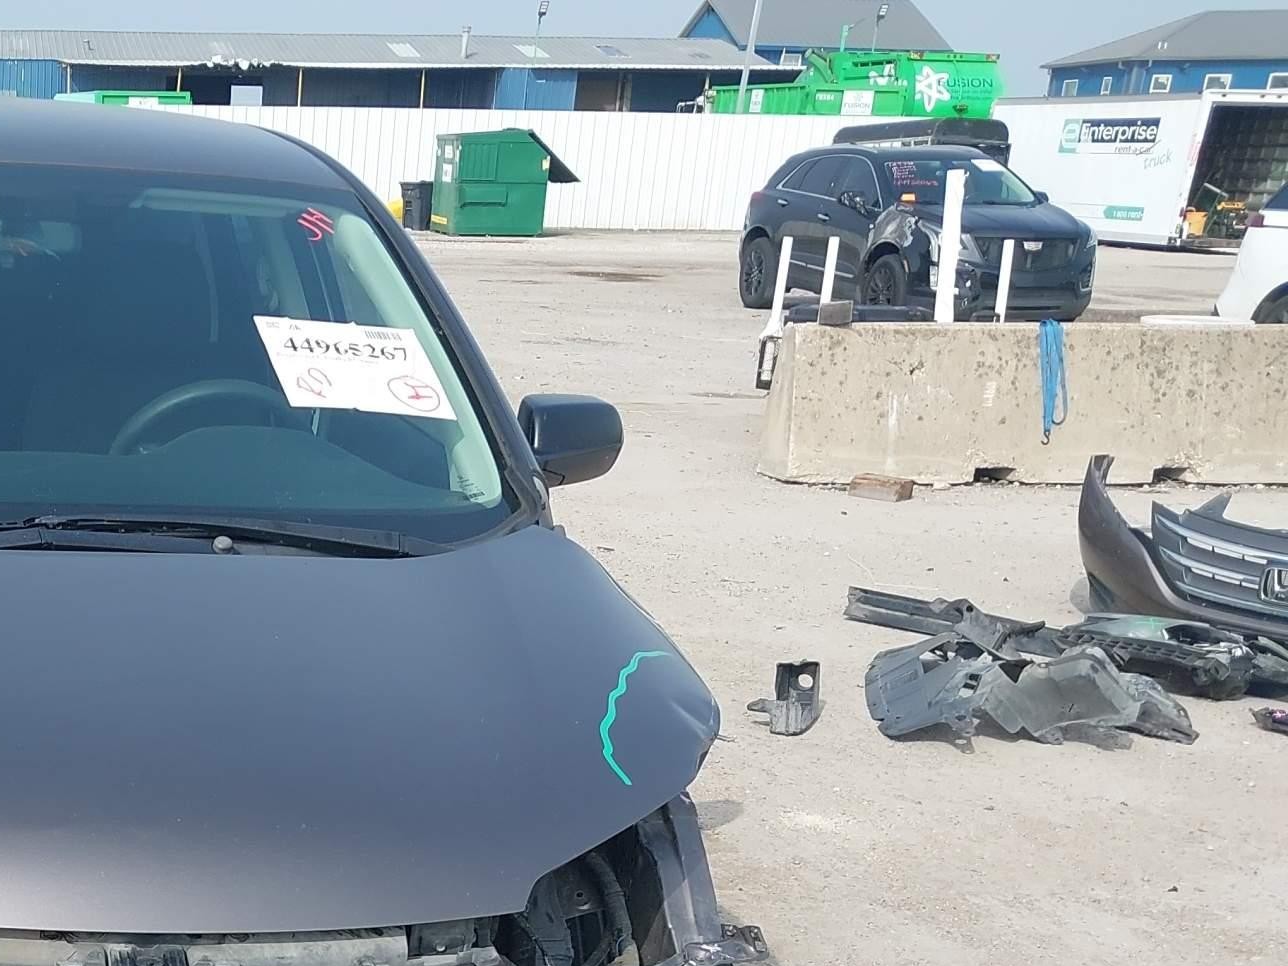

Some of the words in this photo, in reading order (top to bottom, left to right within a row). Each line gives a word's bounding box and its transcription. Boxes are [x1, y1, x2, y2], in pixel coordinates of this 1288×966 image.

[1081, 121, 1158, 143] Enterprise
[1144, 149, 1174, 169] truck
[283, 336, 408, 361] 44965267
